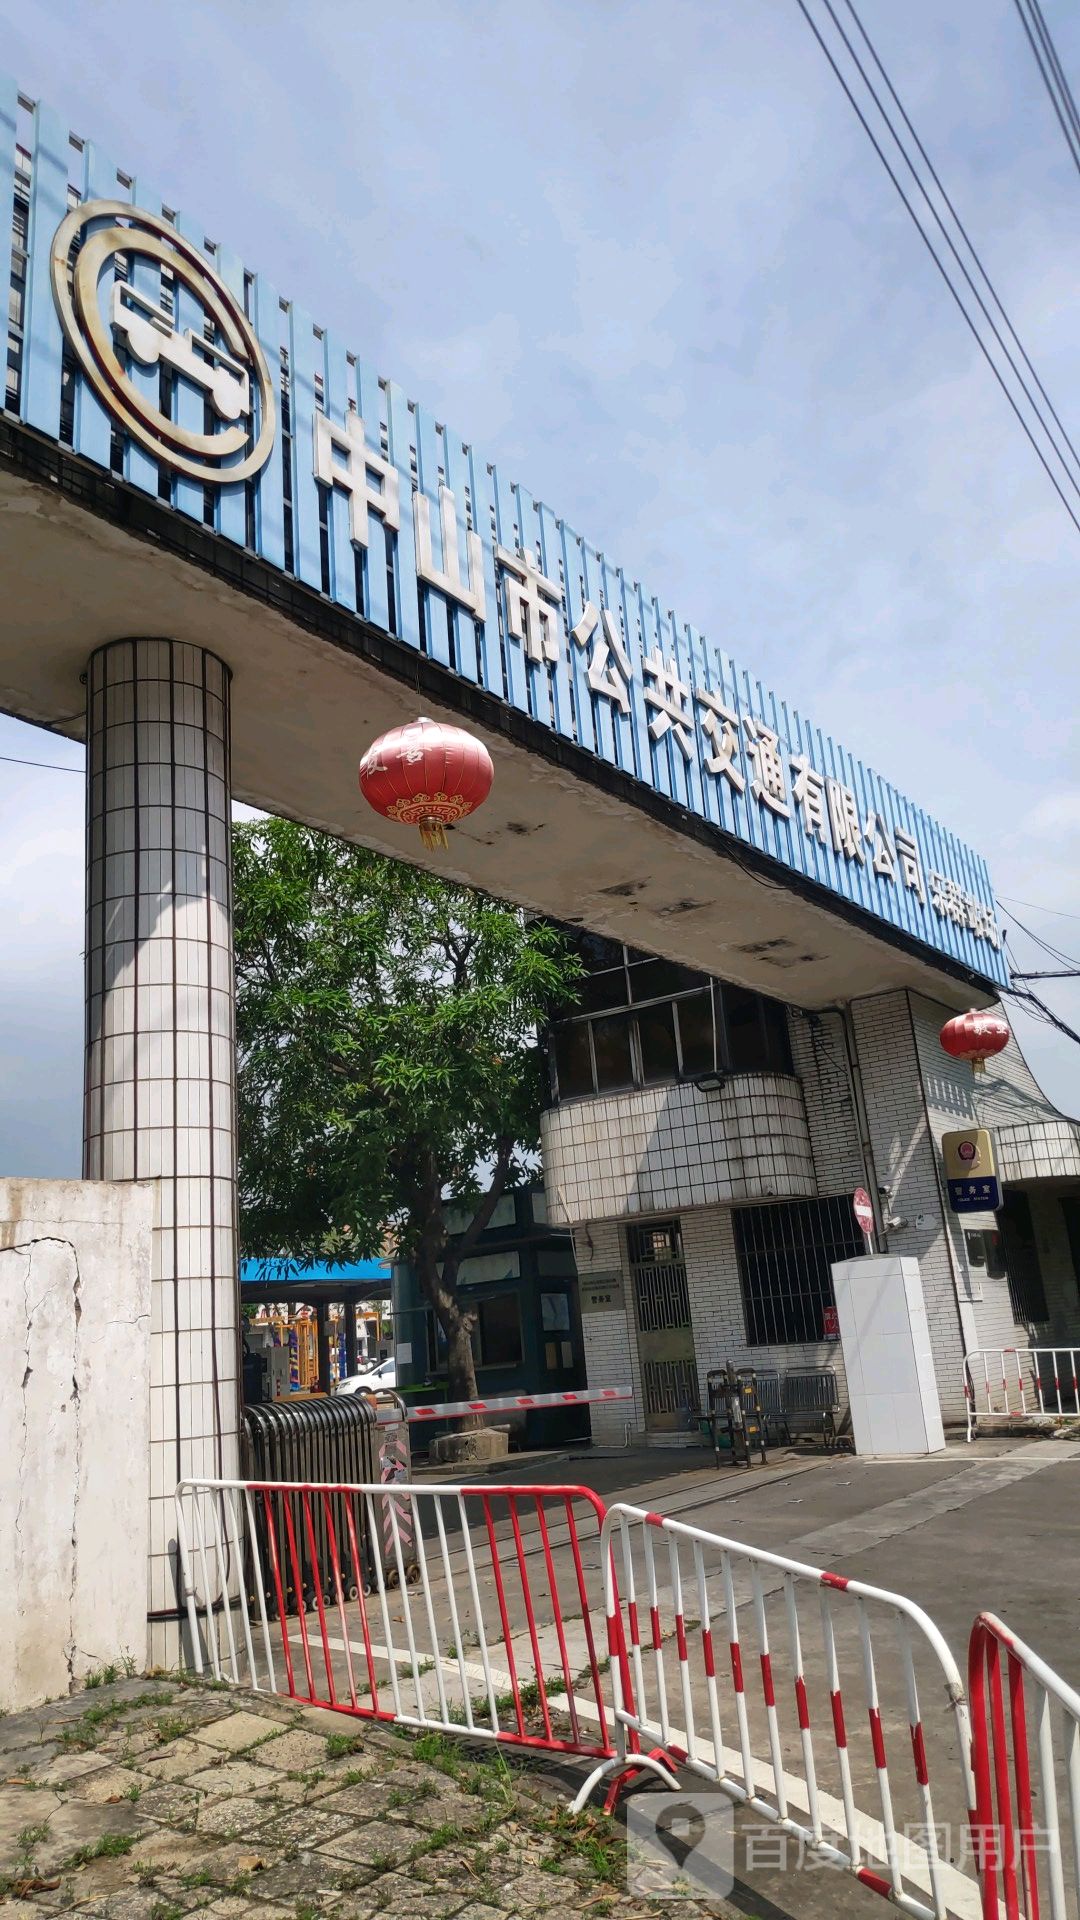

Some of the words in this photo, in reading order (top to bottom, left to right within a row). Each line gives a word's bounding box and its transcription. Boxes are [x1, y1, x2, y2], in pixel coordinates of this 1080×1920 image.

[312, 408, 926, 907] 中山市公共交通有限公司
